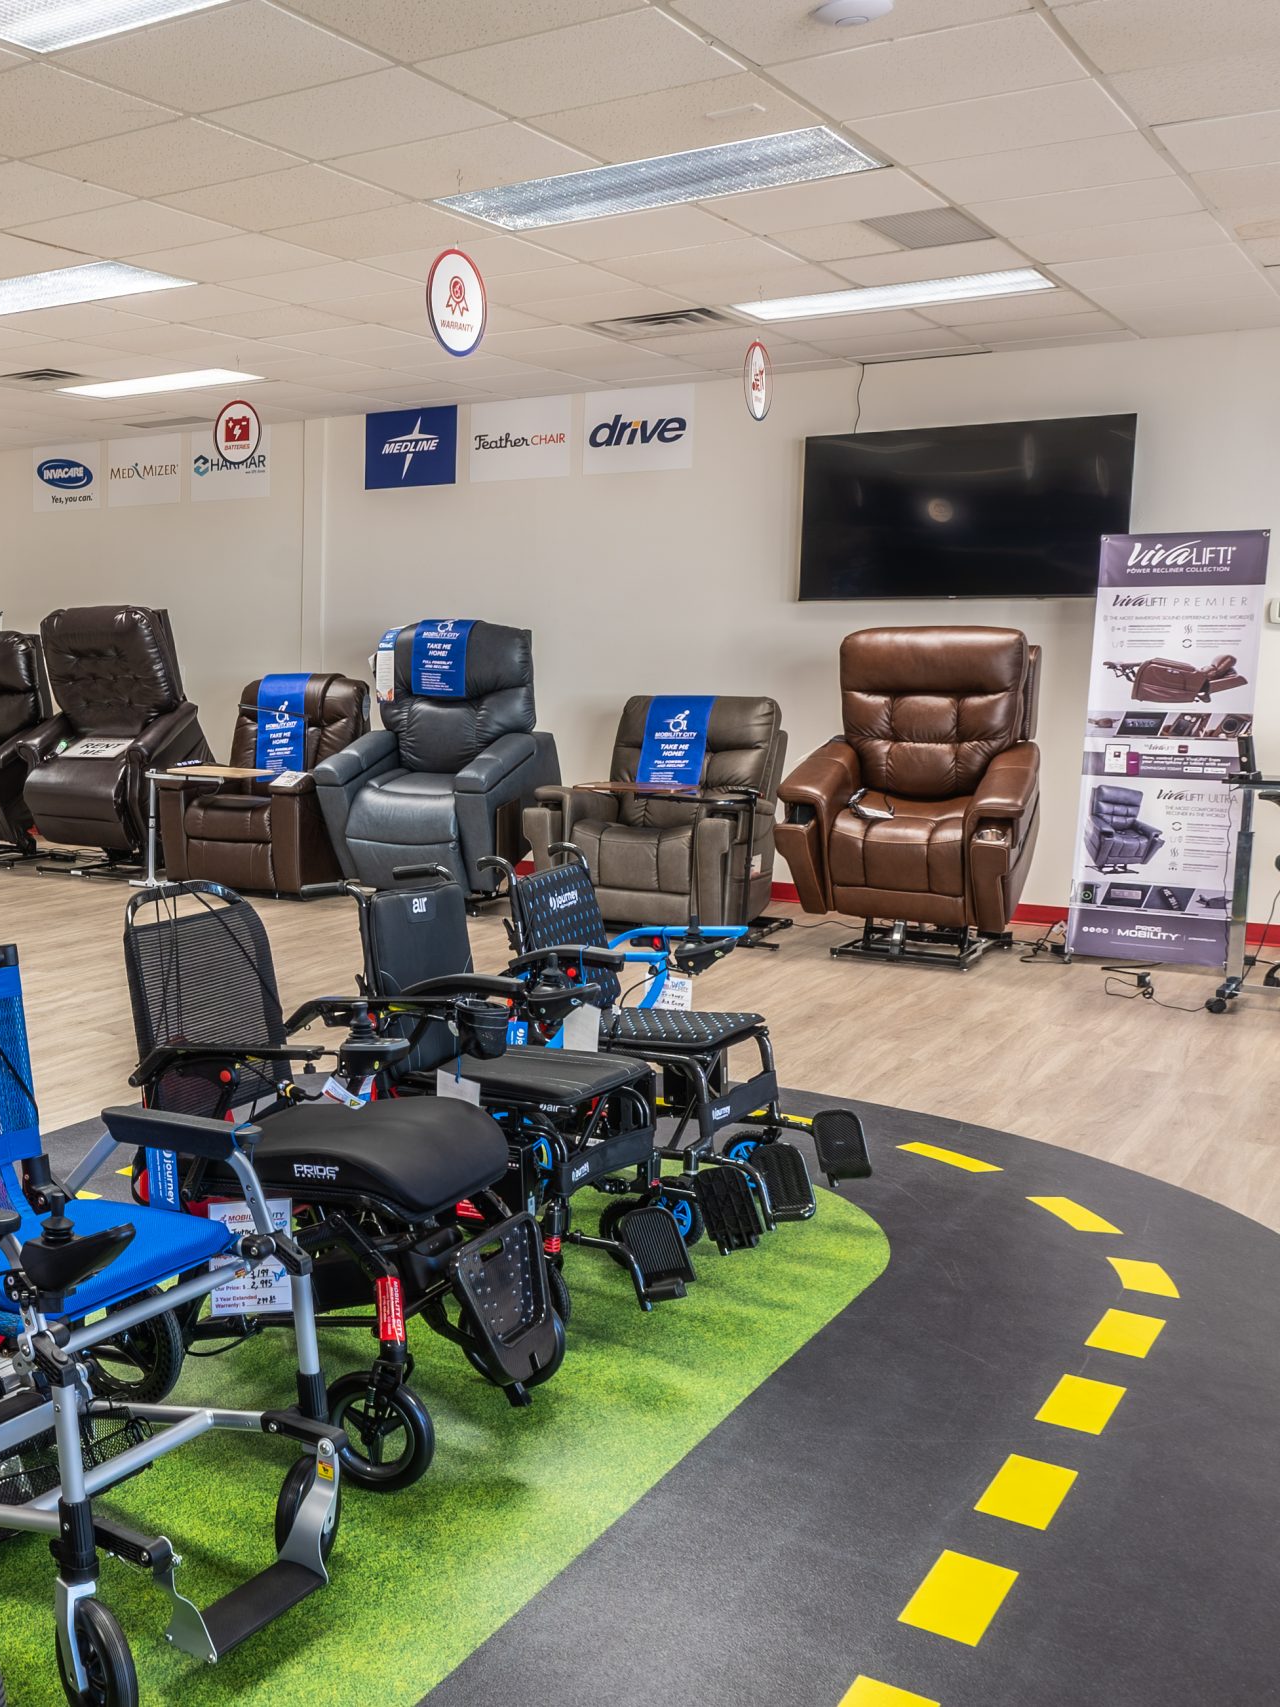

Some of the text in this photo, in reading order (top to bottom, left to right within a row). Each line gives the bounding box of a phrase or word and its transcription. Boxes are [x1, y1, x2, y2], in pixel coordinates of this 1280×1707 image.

[440, 319, 474, 333] WARRANTY
[588, 414, 687, 449] drive
[381, 439, 440, 455] MEDLINE
[474, 432, 566, 450] Feather CHAIR
[44, 466, 84, 480] INVACARE
[51, 494, 93, 504] Yes, you can.
[1173, 596, 1248, 606] PREMIER
[426, 642, 441, 650] TAKE
[1208, 794, 1238, 804] ULTRA
[412, 896, 428, 914] air
[556, 889, 578, 910] journey
[1117, 928, 1178, 941] MOBILITY
[1134, 924, 1162, 932] PRIDE
[546, 1104, 560, 1112] air
[294, 1164, 336, 1176] PRIDE
[164, 1158, 174, 1204] journey
[228, 1214, 252, 1222] MOBIL
